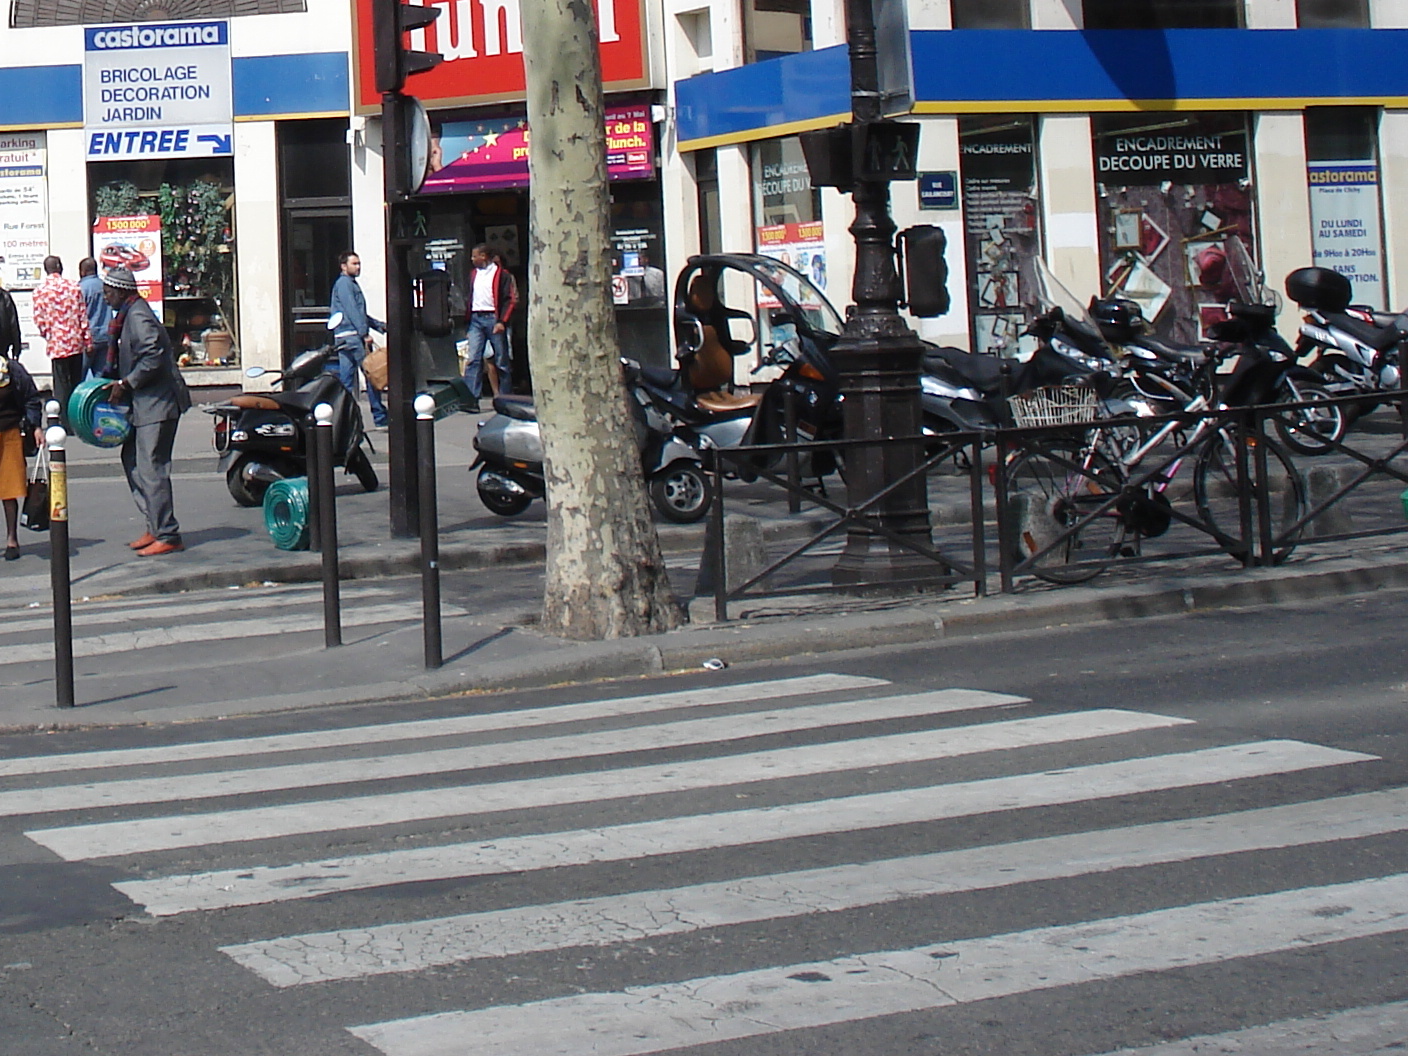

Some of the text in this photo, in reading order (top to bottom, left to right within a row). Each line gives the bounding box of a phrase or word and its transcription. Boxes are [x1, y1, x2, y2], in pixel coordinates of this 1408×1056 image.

[94, 25, 219, 48] castorama
[100, 65, 197, 83] BRICOLAGE
[101, 85, 210, 103] DECORATION
[102, 106, 162, 122] JARDIN
[615, 122, 631, 134] de
[633, 121, 646, 132] la
[88, 129, 190, 155] ENTREE
[1116, 136, 1223, 152] ENCADREMENT
[1099, 153, 1242, 171] DECOUPE DU VERRE
[1309, 170, 1377, 183] astorama
[792, 177, 804, 192] DU
[1321, 219, 1363, 229] DU LUNDI
[1318, 229, 1367, 238] AU SAMEDI
[3, 240, 17, 248] 100
[1344, 248, 1350, 257] à
[1333, 265, 1356, 273] SANS
